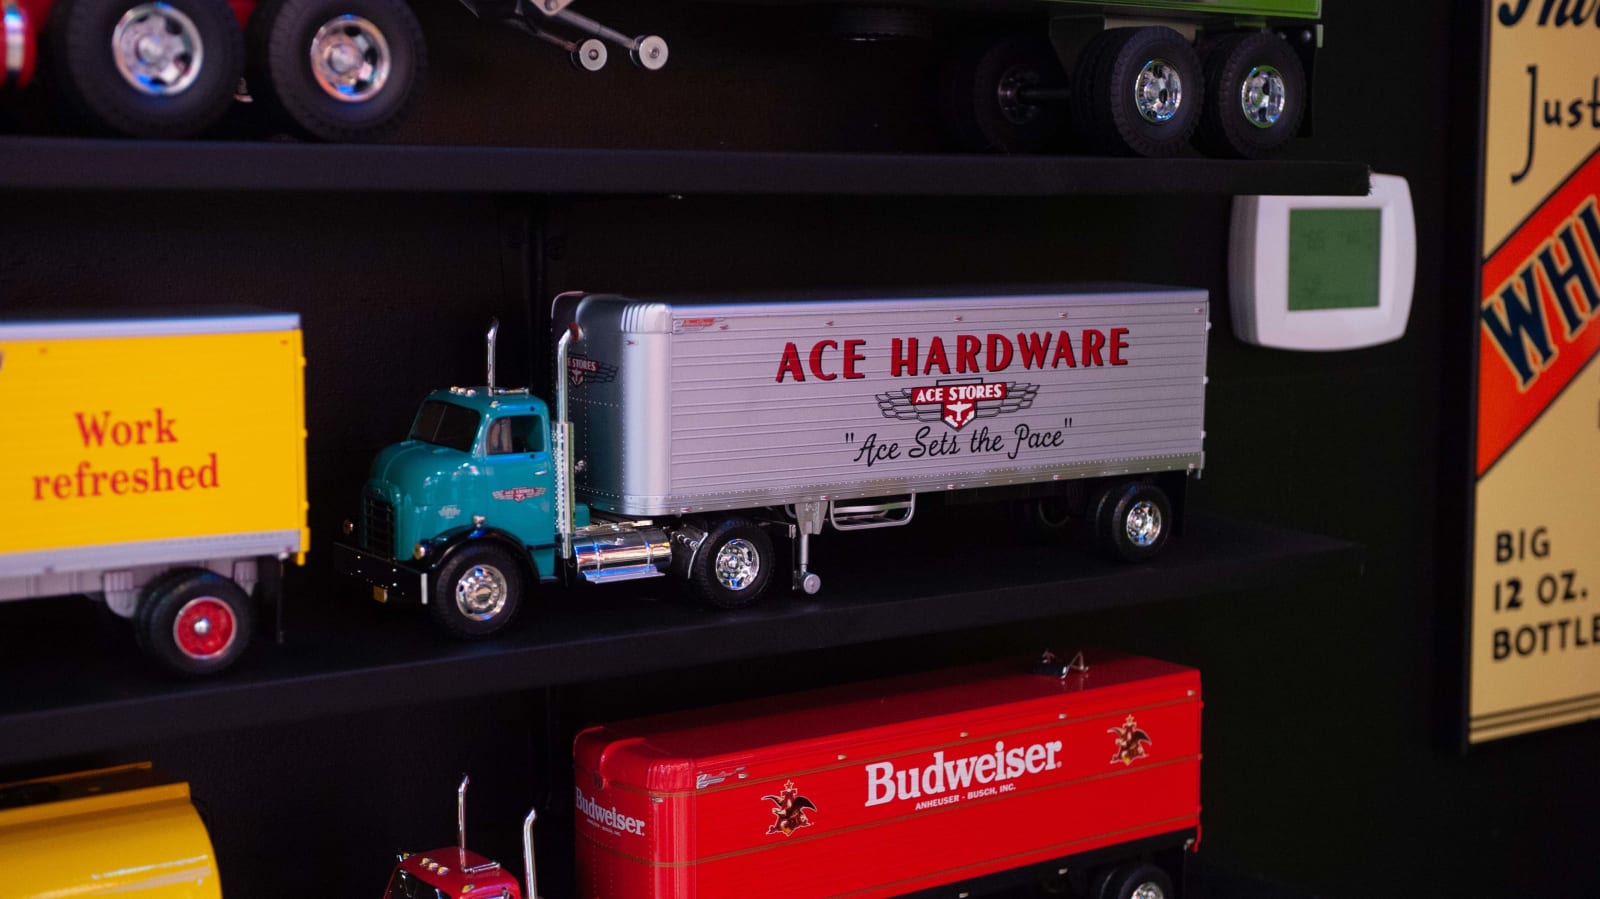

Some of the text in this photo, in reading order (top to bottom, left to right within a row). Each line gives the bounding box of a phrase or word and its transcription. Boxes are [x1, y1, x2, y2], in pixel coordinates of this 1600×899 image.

[1511, 64, 1600, 184] Just
[775, 327, 1131, 383] ACE HARDWARE
[914, 384, 1003, 403] ACE STORES
[74, 407, 179, 448] Work
[908, 425, 961, 458] Sets
[970, 425, 1005, 453] the
[32, 452, 220, 501] refreshed
[1495, 526, 1551, 563] BIG
[1494, 570, 1588, 612] 12 OZ.
[1493, 614, 1600, 661] BOTTLE
[915, 794, 960, 811] ANHEUSER
[999, 783, 1017, 794] INC.
